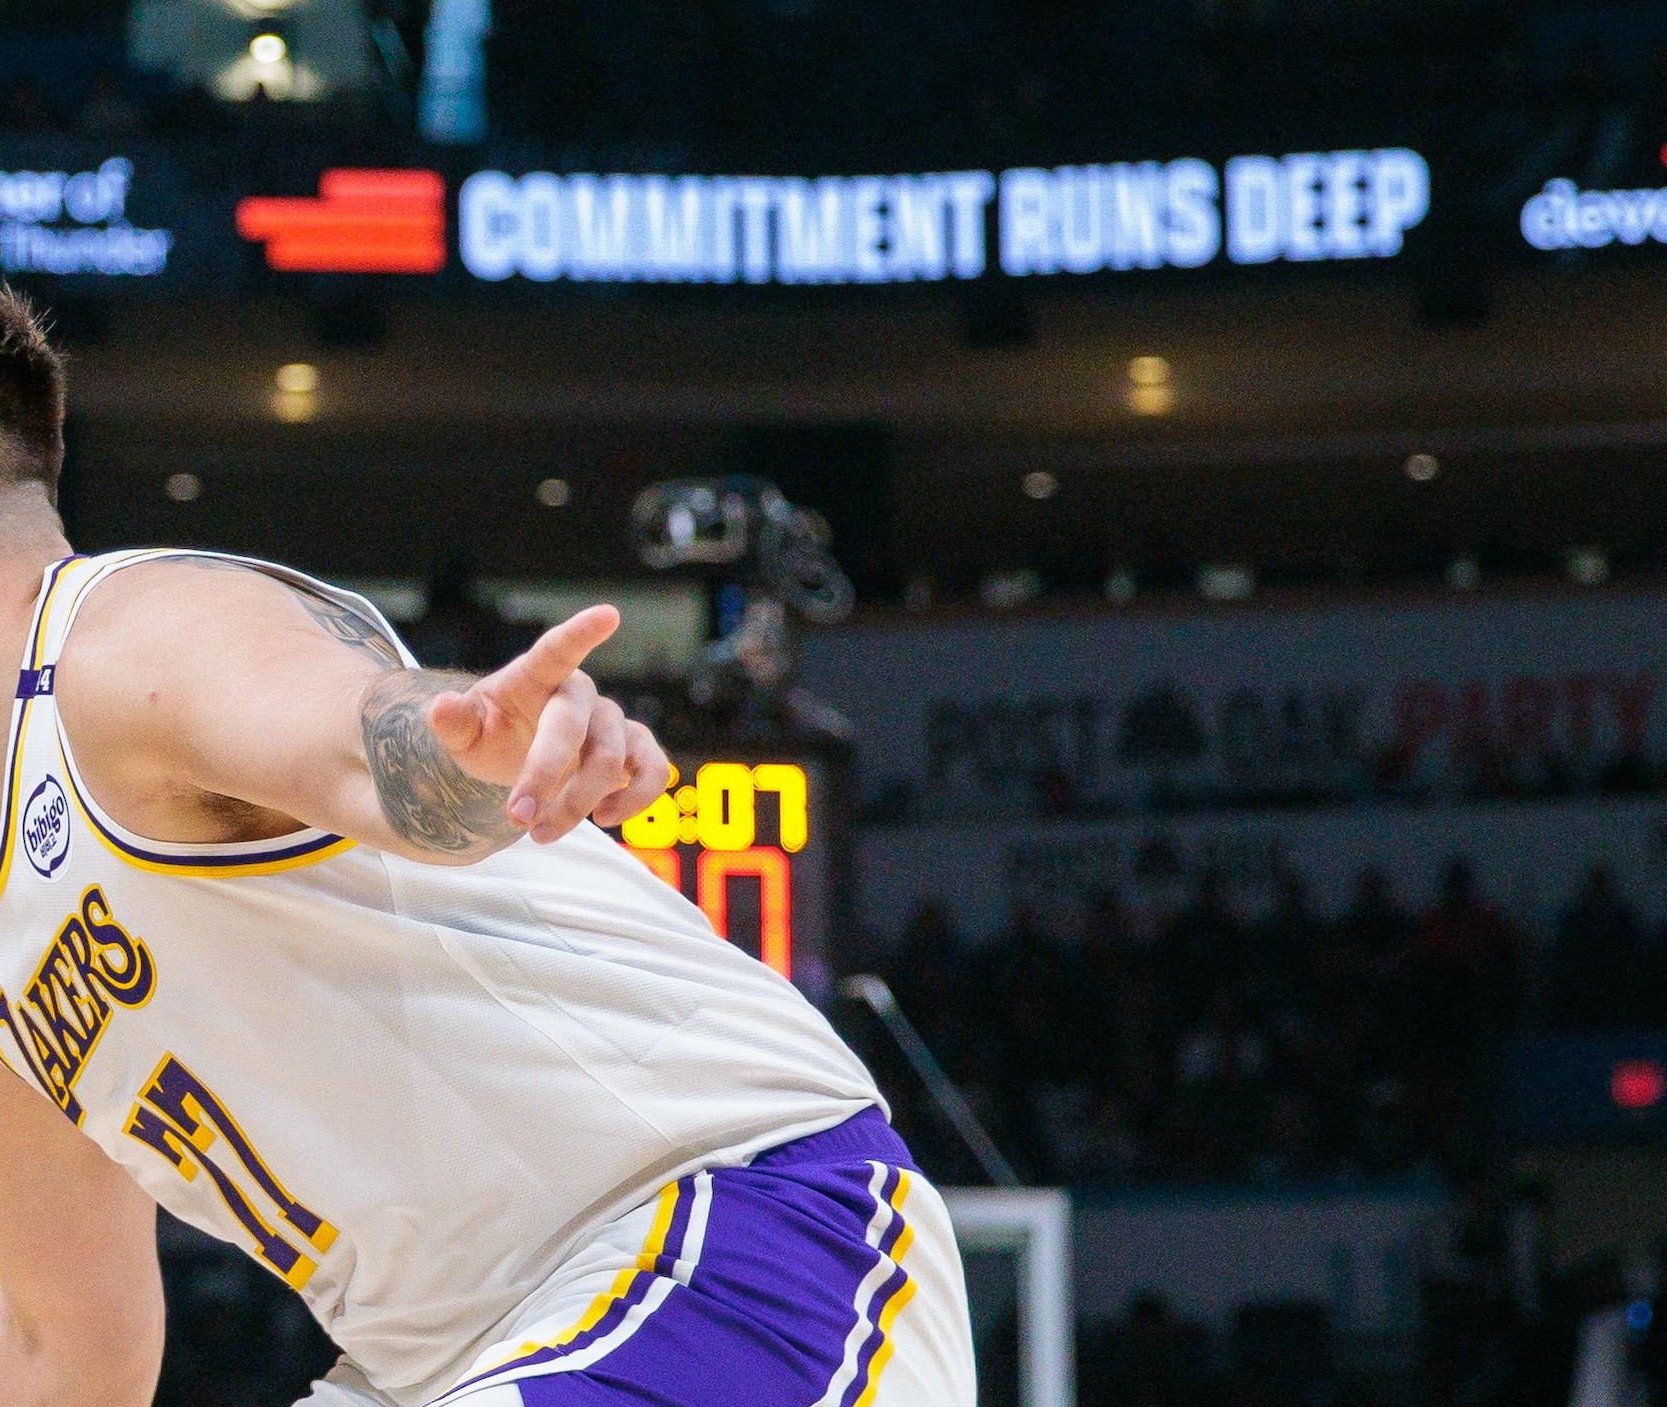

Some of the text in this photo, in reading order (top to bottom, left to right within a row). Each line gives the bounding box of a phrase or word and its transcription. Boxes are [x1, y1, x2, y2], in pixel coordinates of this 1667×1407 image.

[63, 156, 133, 222] of
[459, 147, 1430, 285] COMMITMENT RUNS DEEP
[26, 795, 65, 853] bibigo
[618, 845, 791, 983] 0
[122, 1049, 340, 1292] 77
